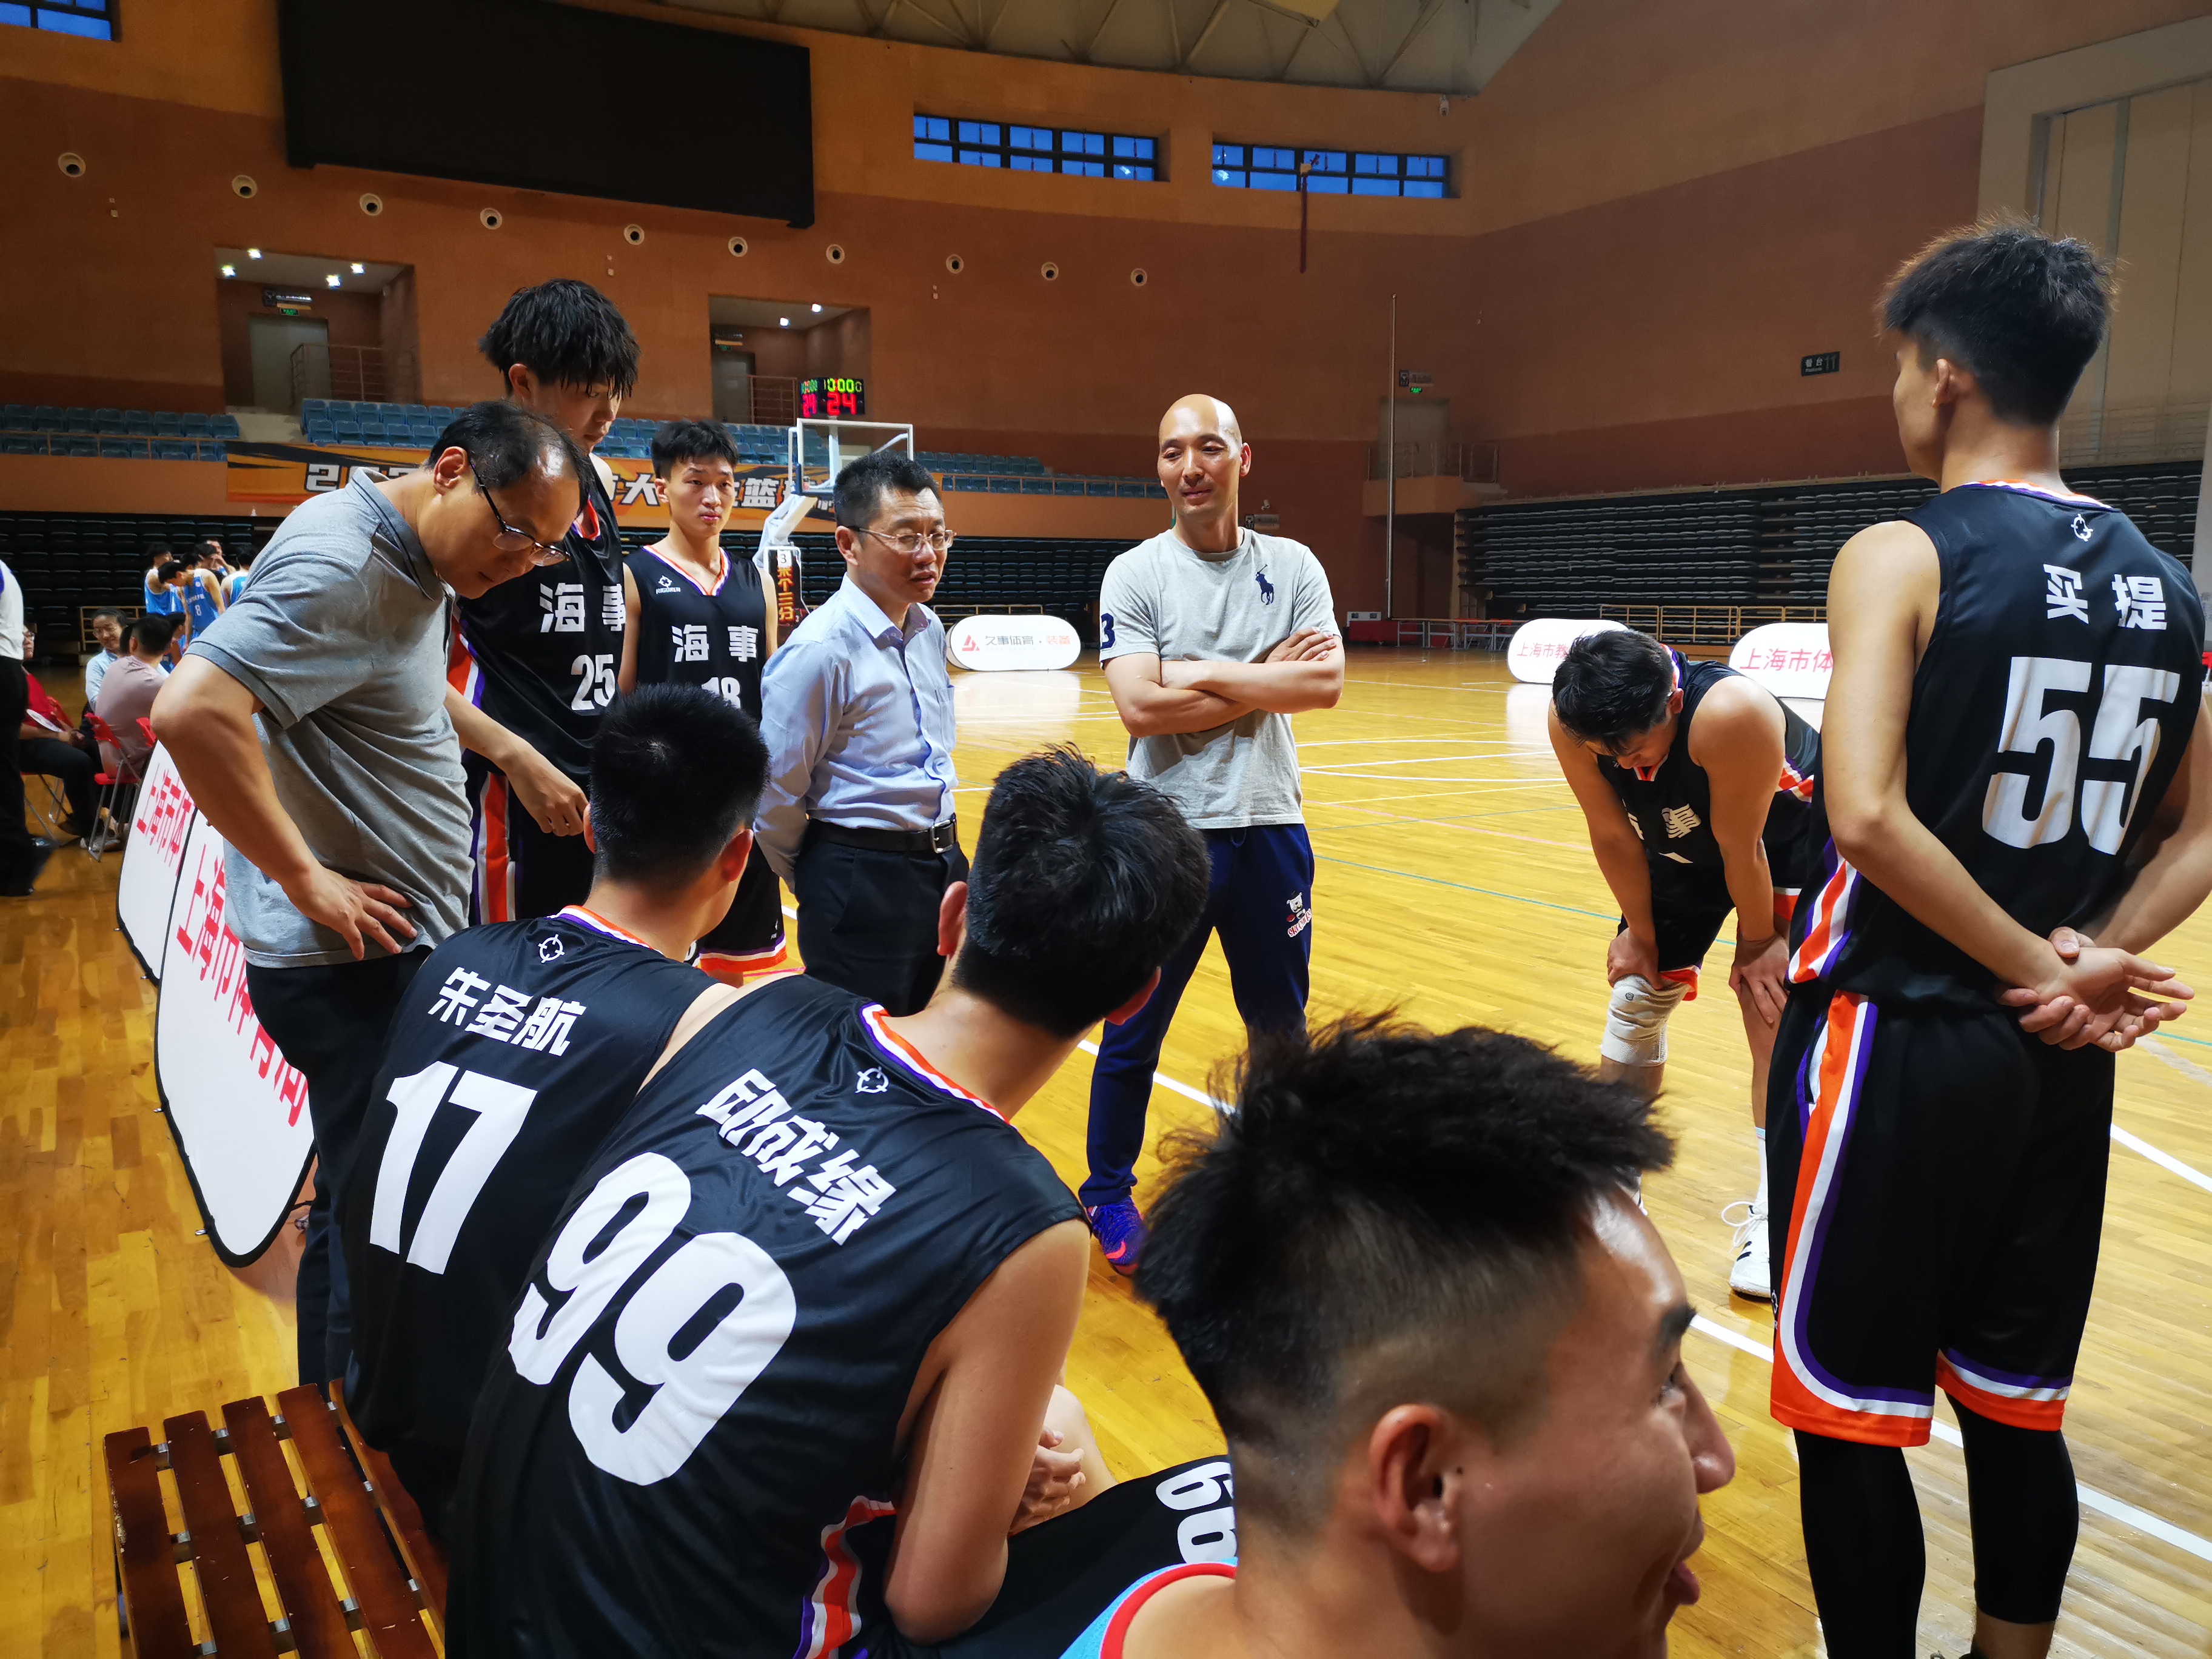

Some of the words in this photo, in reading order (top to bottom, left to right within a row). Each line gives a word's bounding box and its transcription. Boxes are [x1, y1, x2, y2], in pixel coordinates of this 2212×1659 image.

[827, 392, 857, 416] 24
[780, 554, 786, 563] 3
[539, 583, 626, 633] 海事
[2043, 564, 2167, 630] 买提
[672, 625, 759, 662] 海事
[1740, 648, 1833, 672] 上海市体
[571, 654, 615, 711] 25
[1982, 657, 2180, 856] 55
[136, 763, 198, 877] 上海市体
[428, 967, 587, 1057] 朱圣航
[370, 1060, 538, 1275] 17
[508, 1151, 797, 1486] 99
